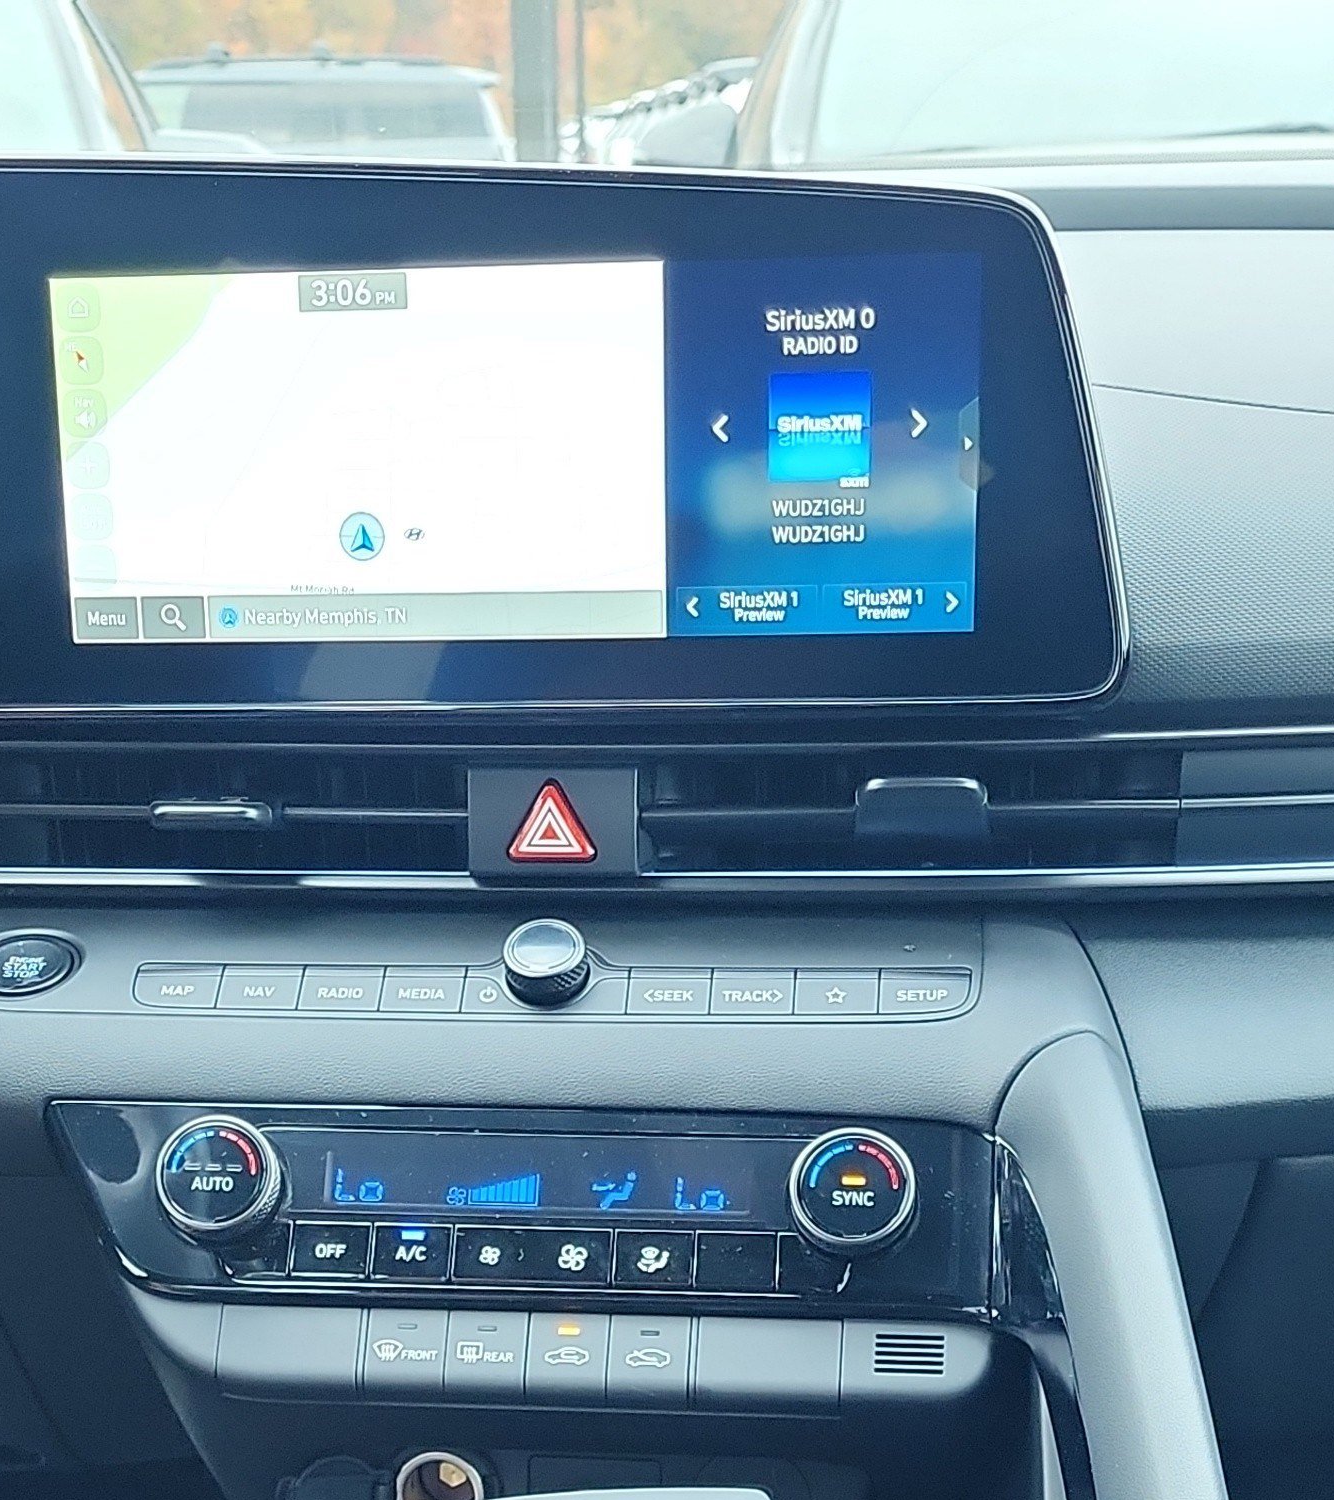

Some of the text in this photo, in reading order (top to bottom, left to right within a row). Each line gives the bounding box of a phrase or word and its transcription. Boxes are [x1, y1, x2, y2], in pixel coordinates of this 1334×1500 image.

[310, 278, 396, 307] 3:06 PM
[765, 307, 856, 332] SiriusXM
[782, 334, 859, 356] RADIO ID
[777, 413, 863, 433] SiriusXM
[772, 498, 866, 518] WUDZ1GHJ
[772, 525, 866, 544] WUDZ1GHJ
[719, 591, 799, 609] SiriusXM 1
[843, 588, 924, 607] SiriusXM 1
[87, 609, 127, 627] Menu
[243, 606, 408, 628] Nearby Memphis, TN
[734, 609, 786, 623] Preview
[858, 606, 910, 620] Preview
[2, 961, 48, 972] START
[2, 970, 41, 979] STOP
[160, 984, 196, 998] MAP
[243, 985, 276, 999] NAV
[317, 986, 364, 1000] RADIO
[397, 987, 446, 1001] MEDIA
[896, 988, 949, 1002] SETUP
[190, 1175, 235, 1193] AUTO
[831, 1190, 876, 1208] SYNC
[314, 1242, 348, 1260] OFF
[394, 1244, 428, 1263] A/C
[400, 1348, 439, 1362] FRONT
[483, 1350, 515, 1364] REAR
